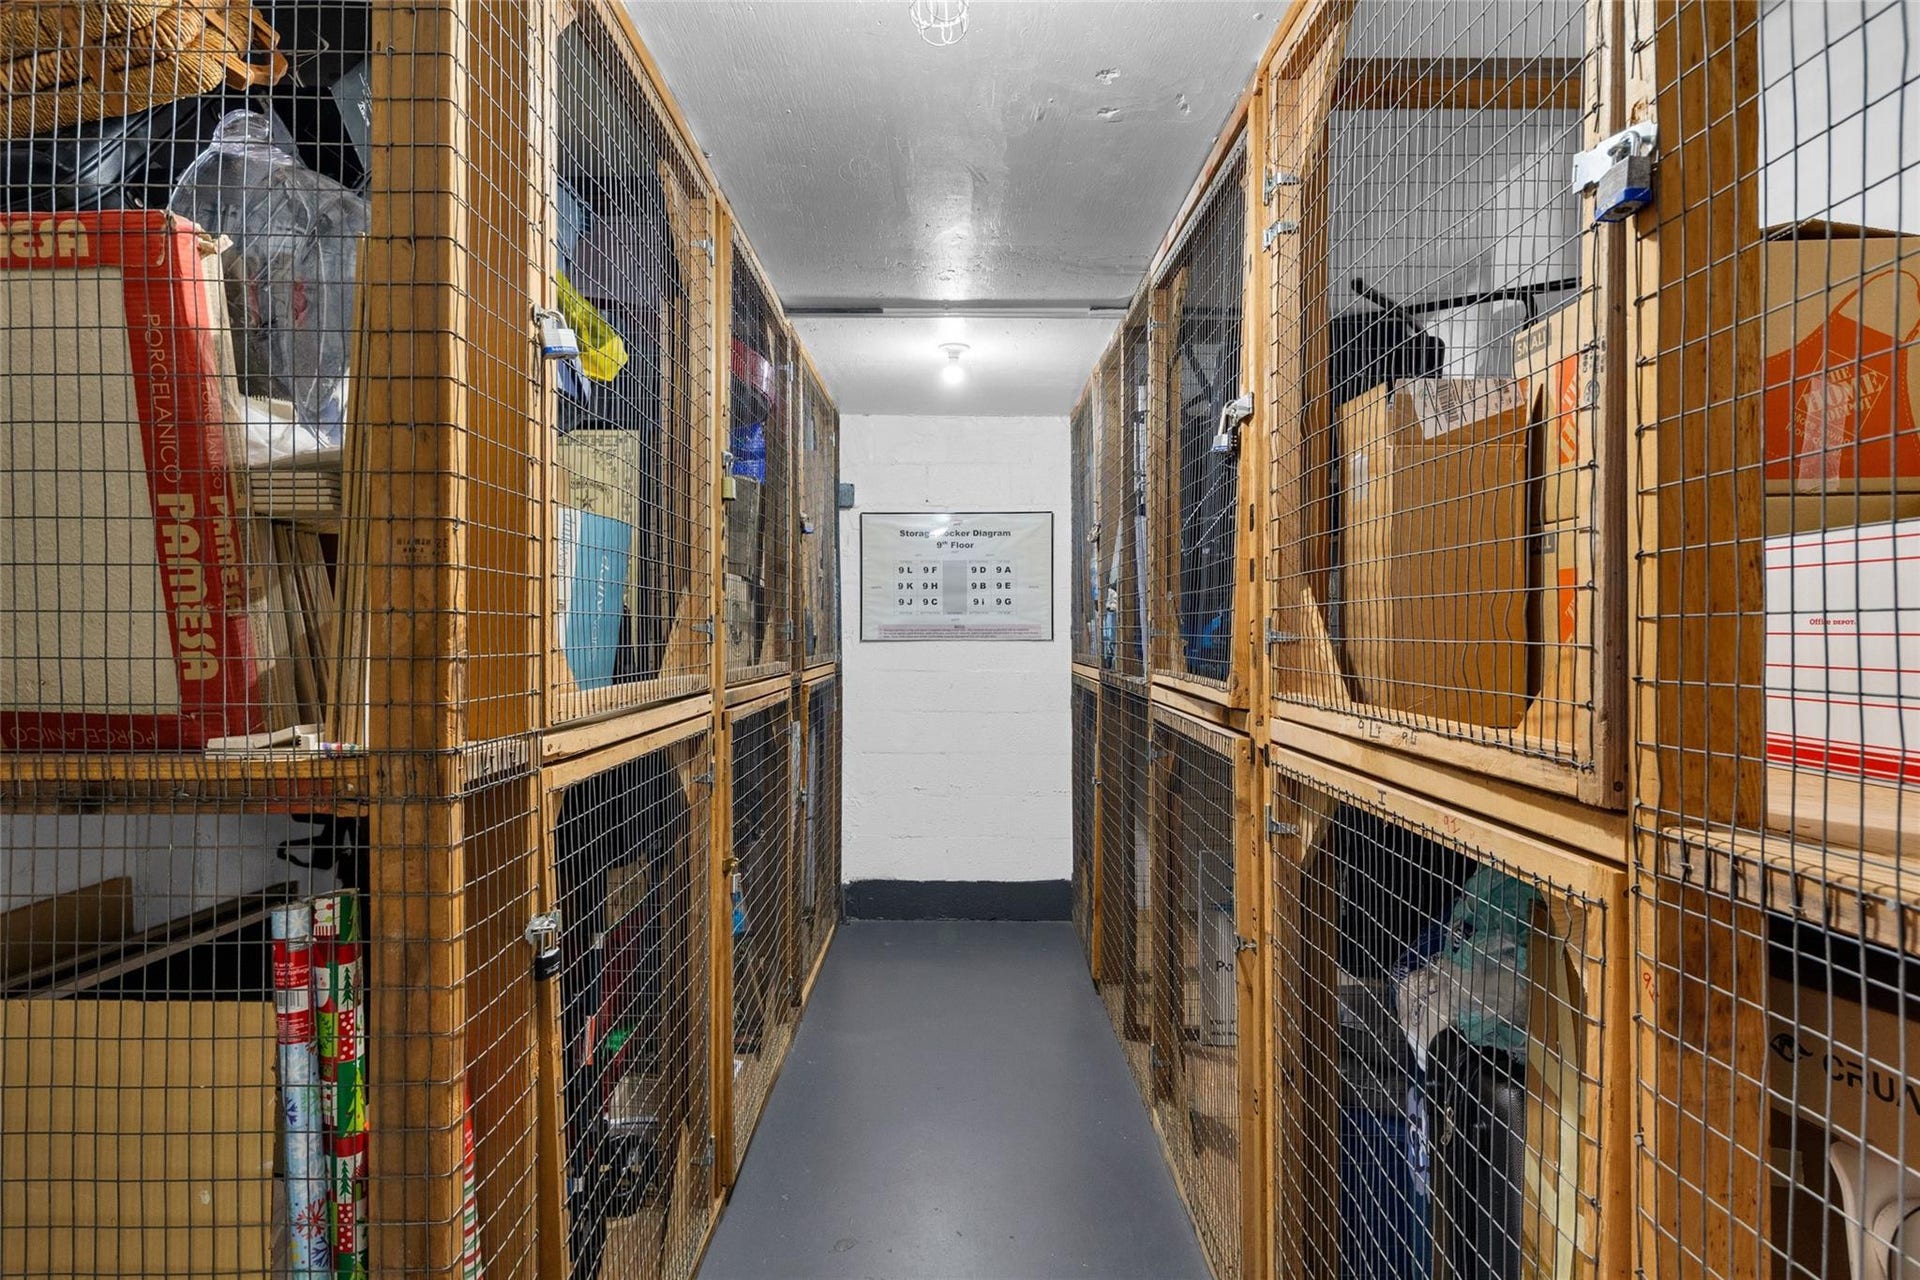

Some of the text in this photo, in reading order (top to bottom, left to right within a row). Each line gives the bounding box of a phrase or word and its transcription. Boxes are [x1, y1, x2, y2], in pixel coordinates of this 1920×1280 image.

[0, 218, 90, 259] ESA
[142, 313, 182, 484] PORCELANICO
[900, 530, 934, 538] Storag
[973, 530, 1011, 538] Diagram
[951, 541, 974, 549] Floor
[156, 493, 220, 681] PAMESA
